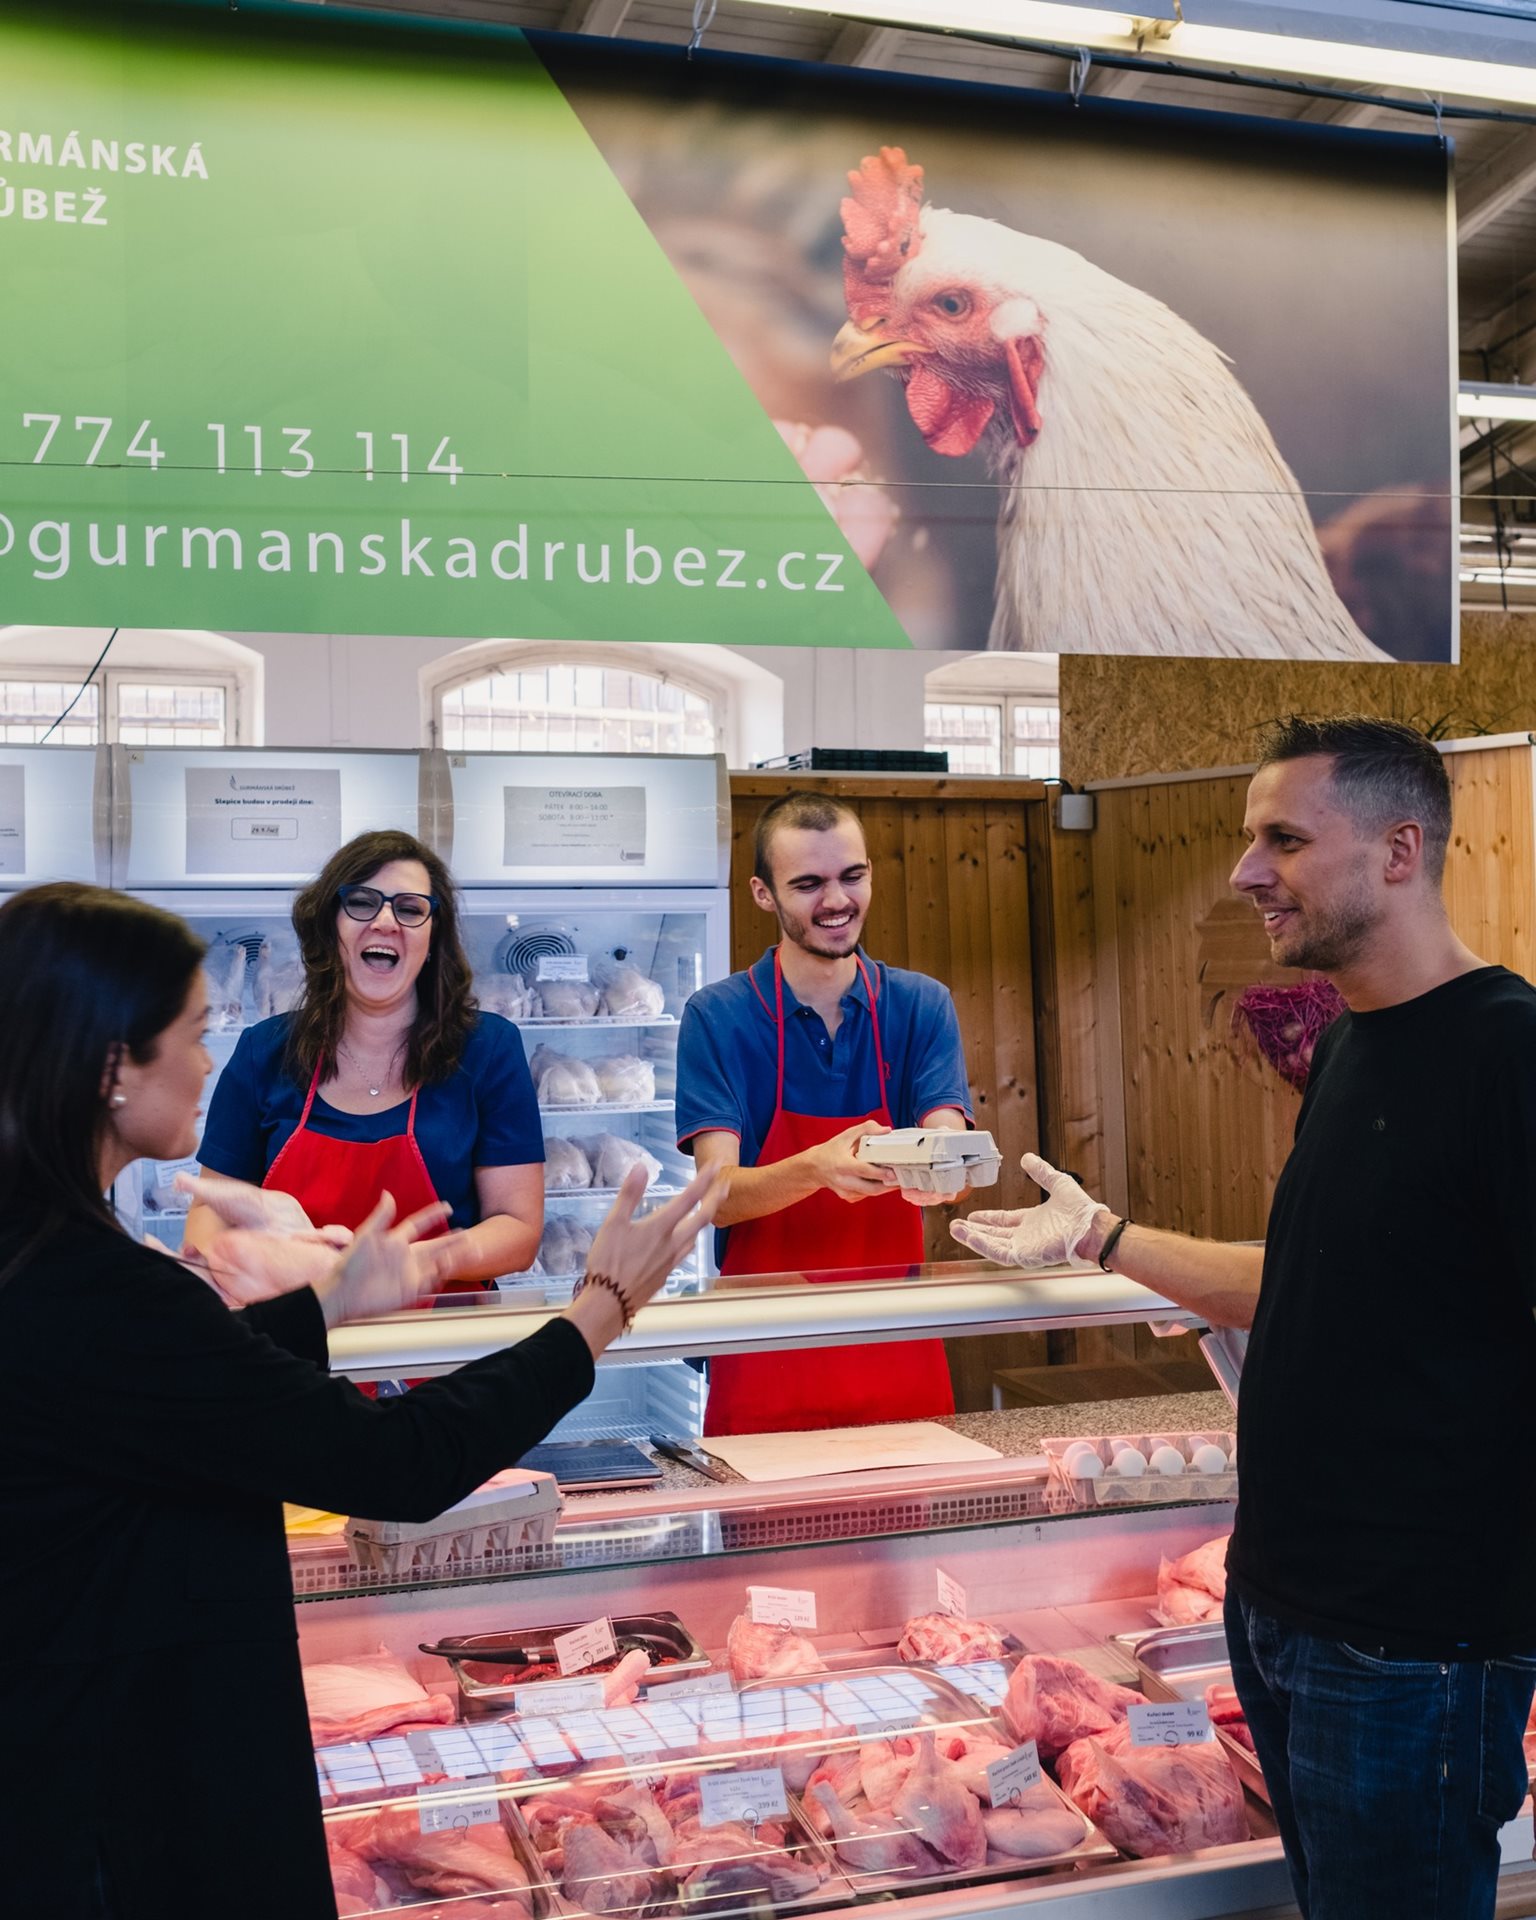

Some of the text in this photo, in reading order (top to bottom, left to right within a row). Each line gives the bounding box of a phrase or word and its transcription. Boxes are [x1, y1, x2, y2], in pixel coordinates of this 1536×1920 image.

[23, 412, 464, 485] 774 113 114
[549, 790, 583, 798] OTEVÍRACÍ
[214, 798, 241, 806] Slepice
[272, 798, 297, 806] prodeji
